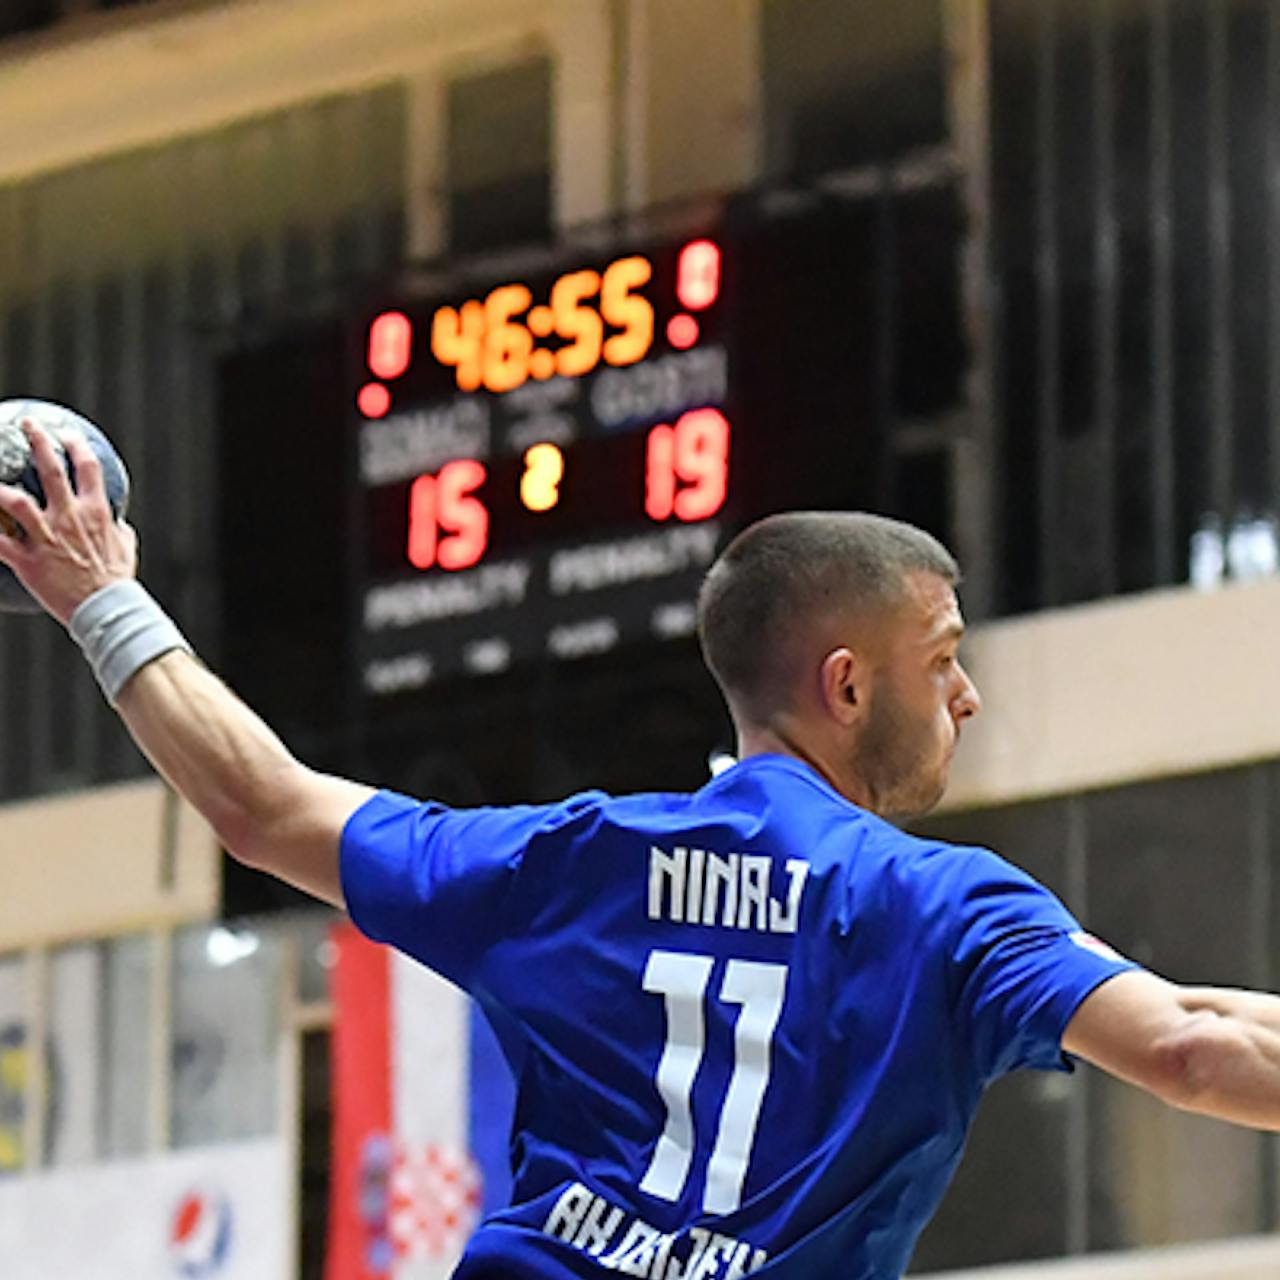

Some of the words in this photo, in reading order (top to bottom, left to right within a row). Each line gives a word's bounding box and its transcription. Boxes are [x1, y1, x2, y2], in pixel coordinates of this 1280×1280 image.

[430, 256, 654, 392] 46:55
[407, 459, 489, 571] 15
[645, 407, 730, 521] 19
[646, 845, 810, 934] NINAJ
[638, 950, 789, 1217] 11
